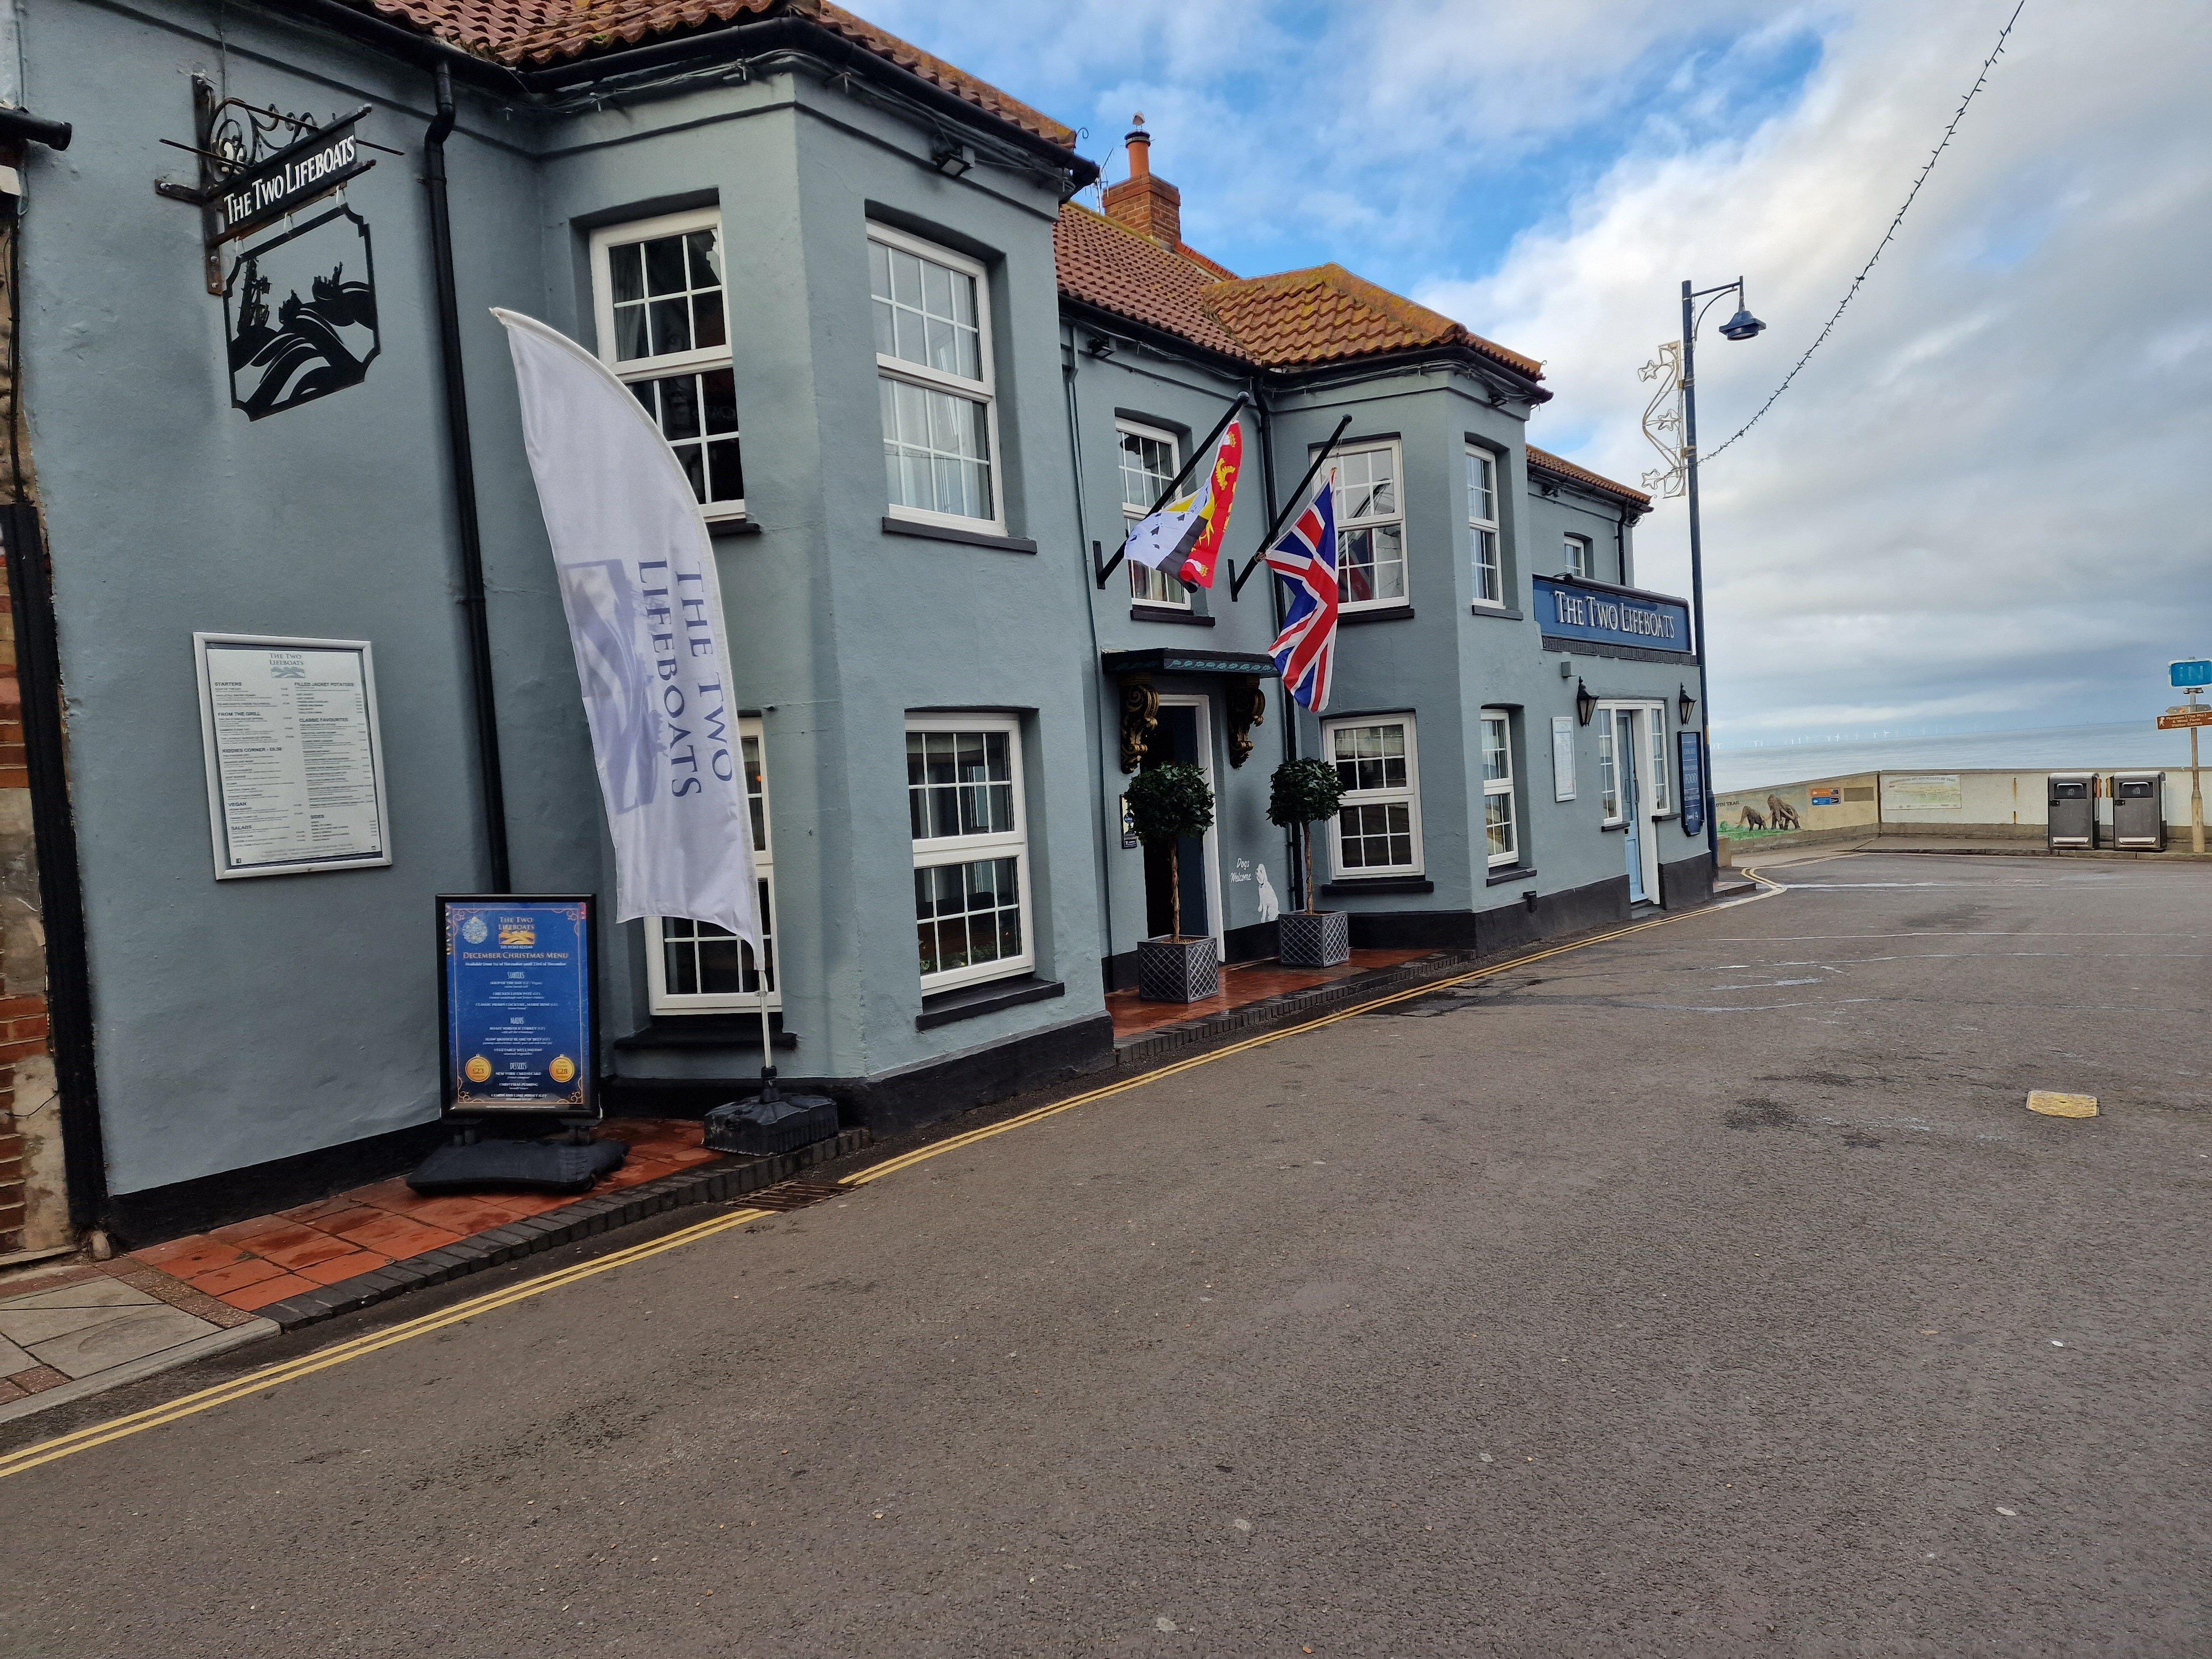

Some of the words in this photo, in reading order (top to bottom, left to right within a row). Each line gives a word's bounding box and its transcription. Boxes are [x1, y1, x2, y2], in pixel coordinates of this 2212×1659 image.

[224, 192, 252, 225] THE
[252, 175, 284, 210] TWO
[285, 135, 356, 194] LIFEBOATS
[1554, 590, 1584, 625] THE
[1584, 596, 1618, 630] TWO
[1619, 603, 1674, 639] LIFEBOATS
[638, 557, 702, 797] LIFEBOATS
[675, 561, 713, 657] THE
[698, 672, 733, 782] TWO
[1685, 774, 1698, 784] FOOD
[1230, 872, 1251, 883] Welcome
[1237, 858, 1250, 870] Dogs
